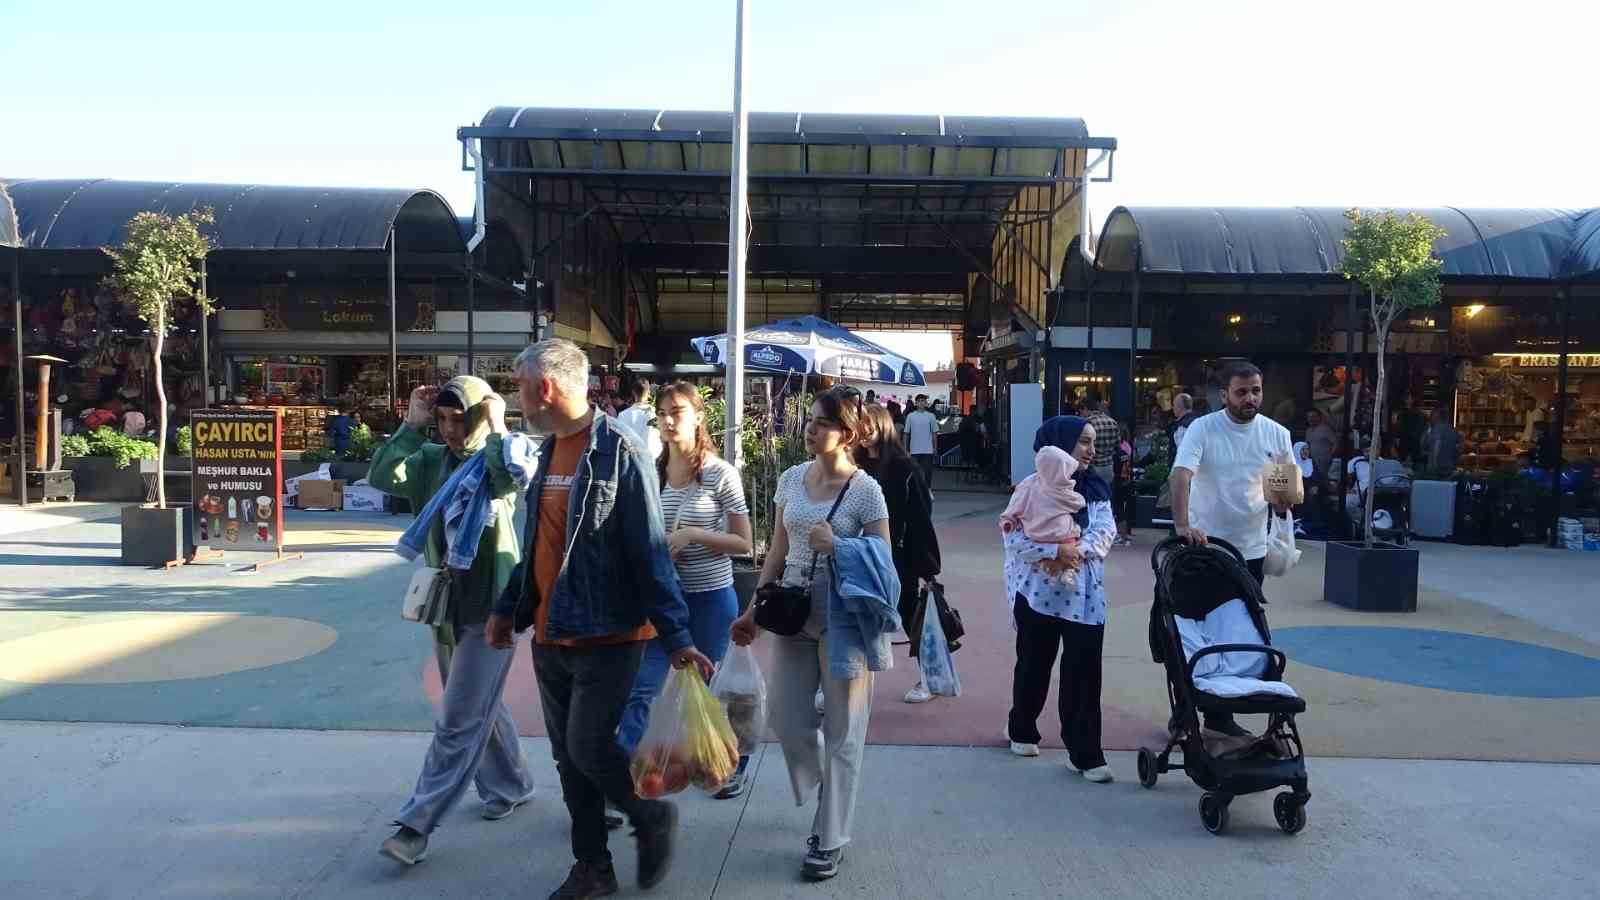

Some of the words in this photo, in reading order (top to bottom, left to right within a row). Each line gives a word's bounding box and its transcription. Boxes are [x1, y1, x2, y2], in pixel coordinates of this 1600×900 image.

[1519, 355, 1587, 367] ERASAN
[195, 421, 274, 446] ÇAYIRCI
[195, 448, 229, 459] HASAN
[197, 466, 238, 477] MEŞHUR
[240, 466, 272, 476] BAKLA
[220, 482, 262, 490] HUMUSU
